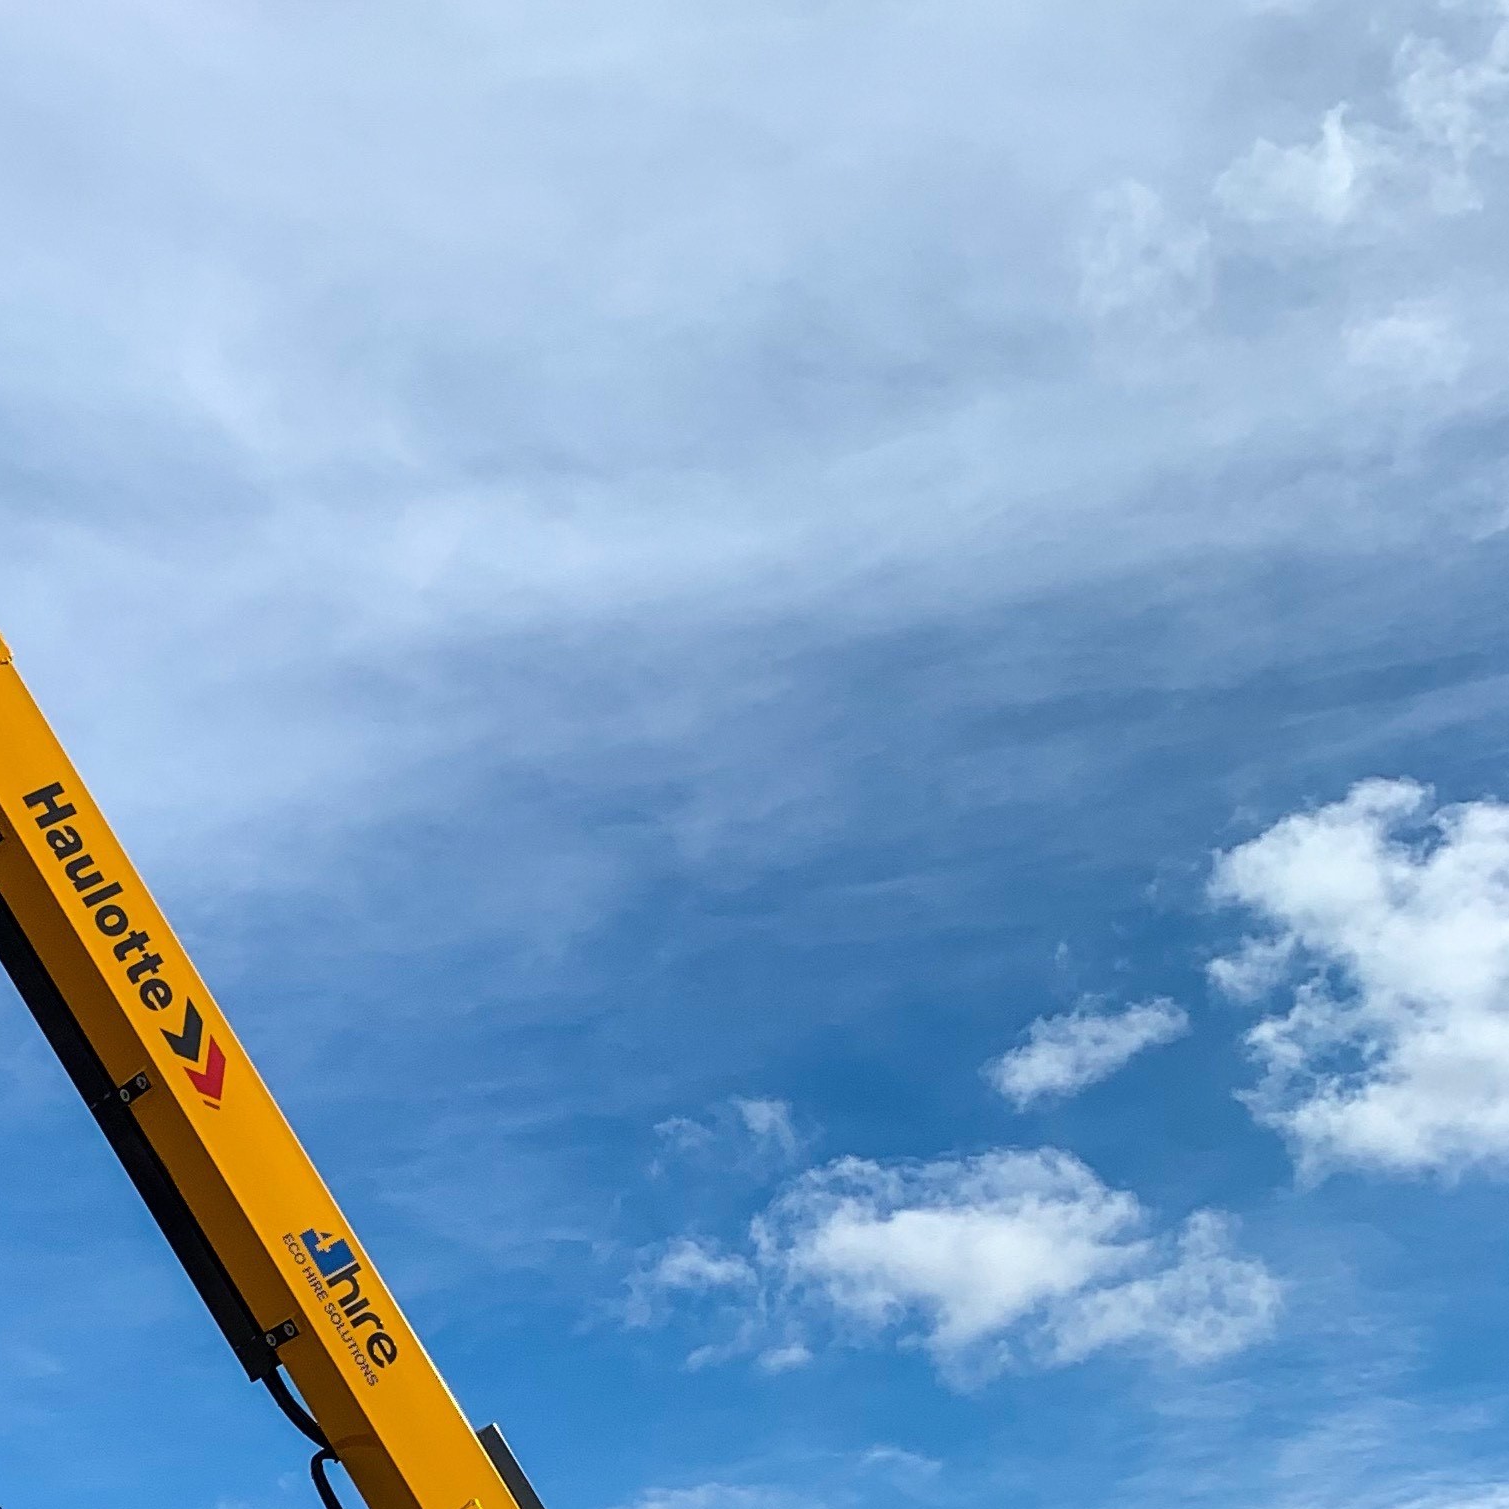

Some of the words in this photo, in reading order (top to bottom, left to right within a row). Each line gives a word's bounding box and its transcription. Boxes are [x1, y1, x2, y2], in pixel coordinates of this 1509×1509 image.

[22, 781, 173, 1011] Haulotte
[282, 1232, 307, 1265] ECO
[302, 1266, 329, 1303] HIRE
[324, 1302, 379, 1387] SOLUTIONS
